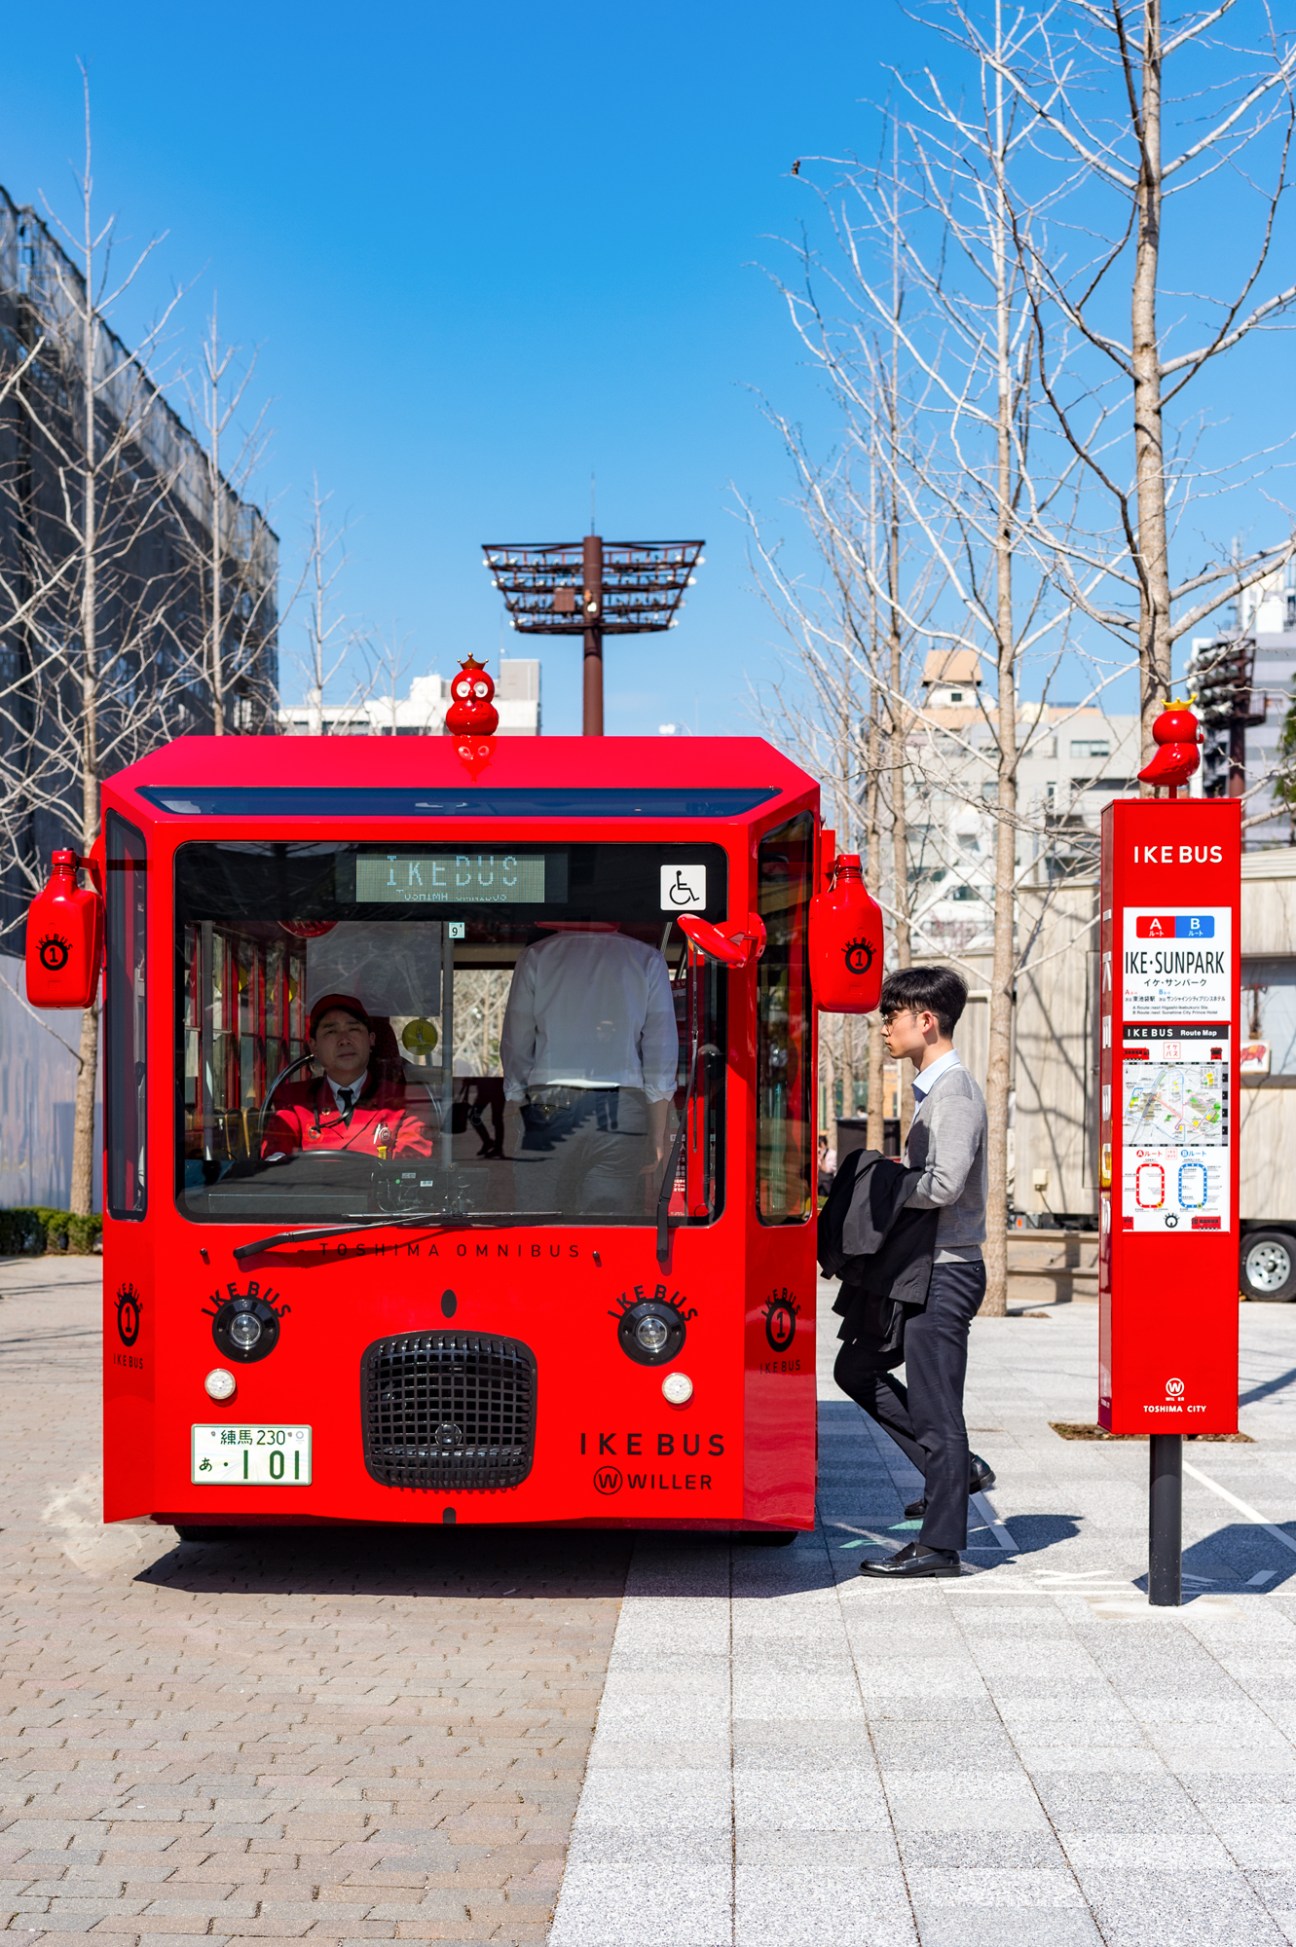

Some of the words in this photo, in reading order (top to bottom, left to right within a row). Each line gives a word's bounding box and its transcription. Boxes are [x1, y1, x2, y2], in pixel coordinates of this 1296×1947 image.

[1150, 918, 1162, 930] A
[1190, 918, 1200, 930] B
[50, 947, 58, 962] 1
[856, 951, 863, 966] 1
[320, 1243, 439, 1257] TOSHIMA
[456, 1244, 579, 1258] OMNIBUS
[126, 1306, 132, 1333] 1
[776, 1312, 786, 1338] 1
[256, 1430, 286, 1446] 230
[199, 1458, 212, 1472] あ
[628, 1474, 712, 1490] WILLER
